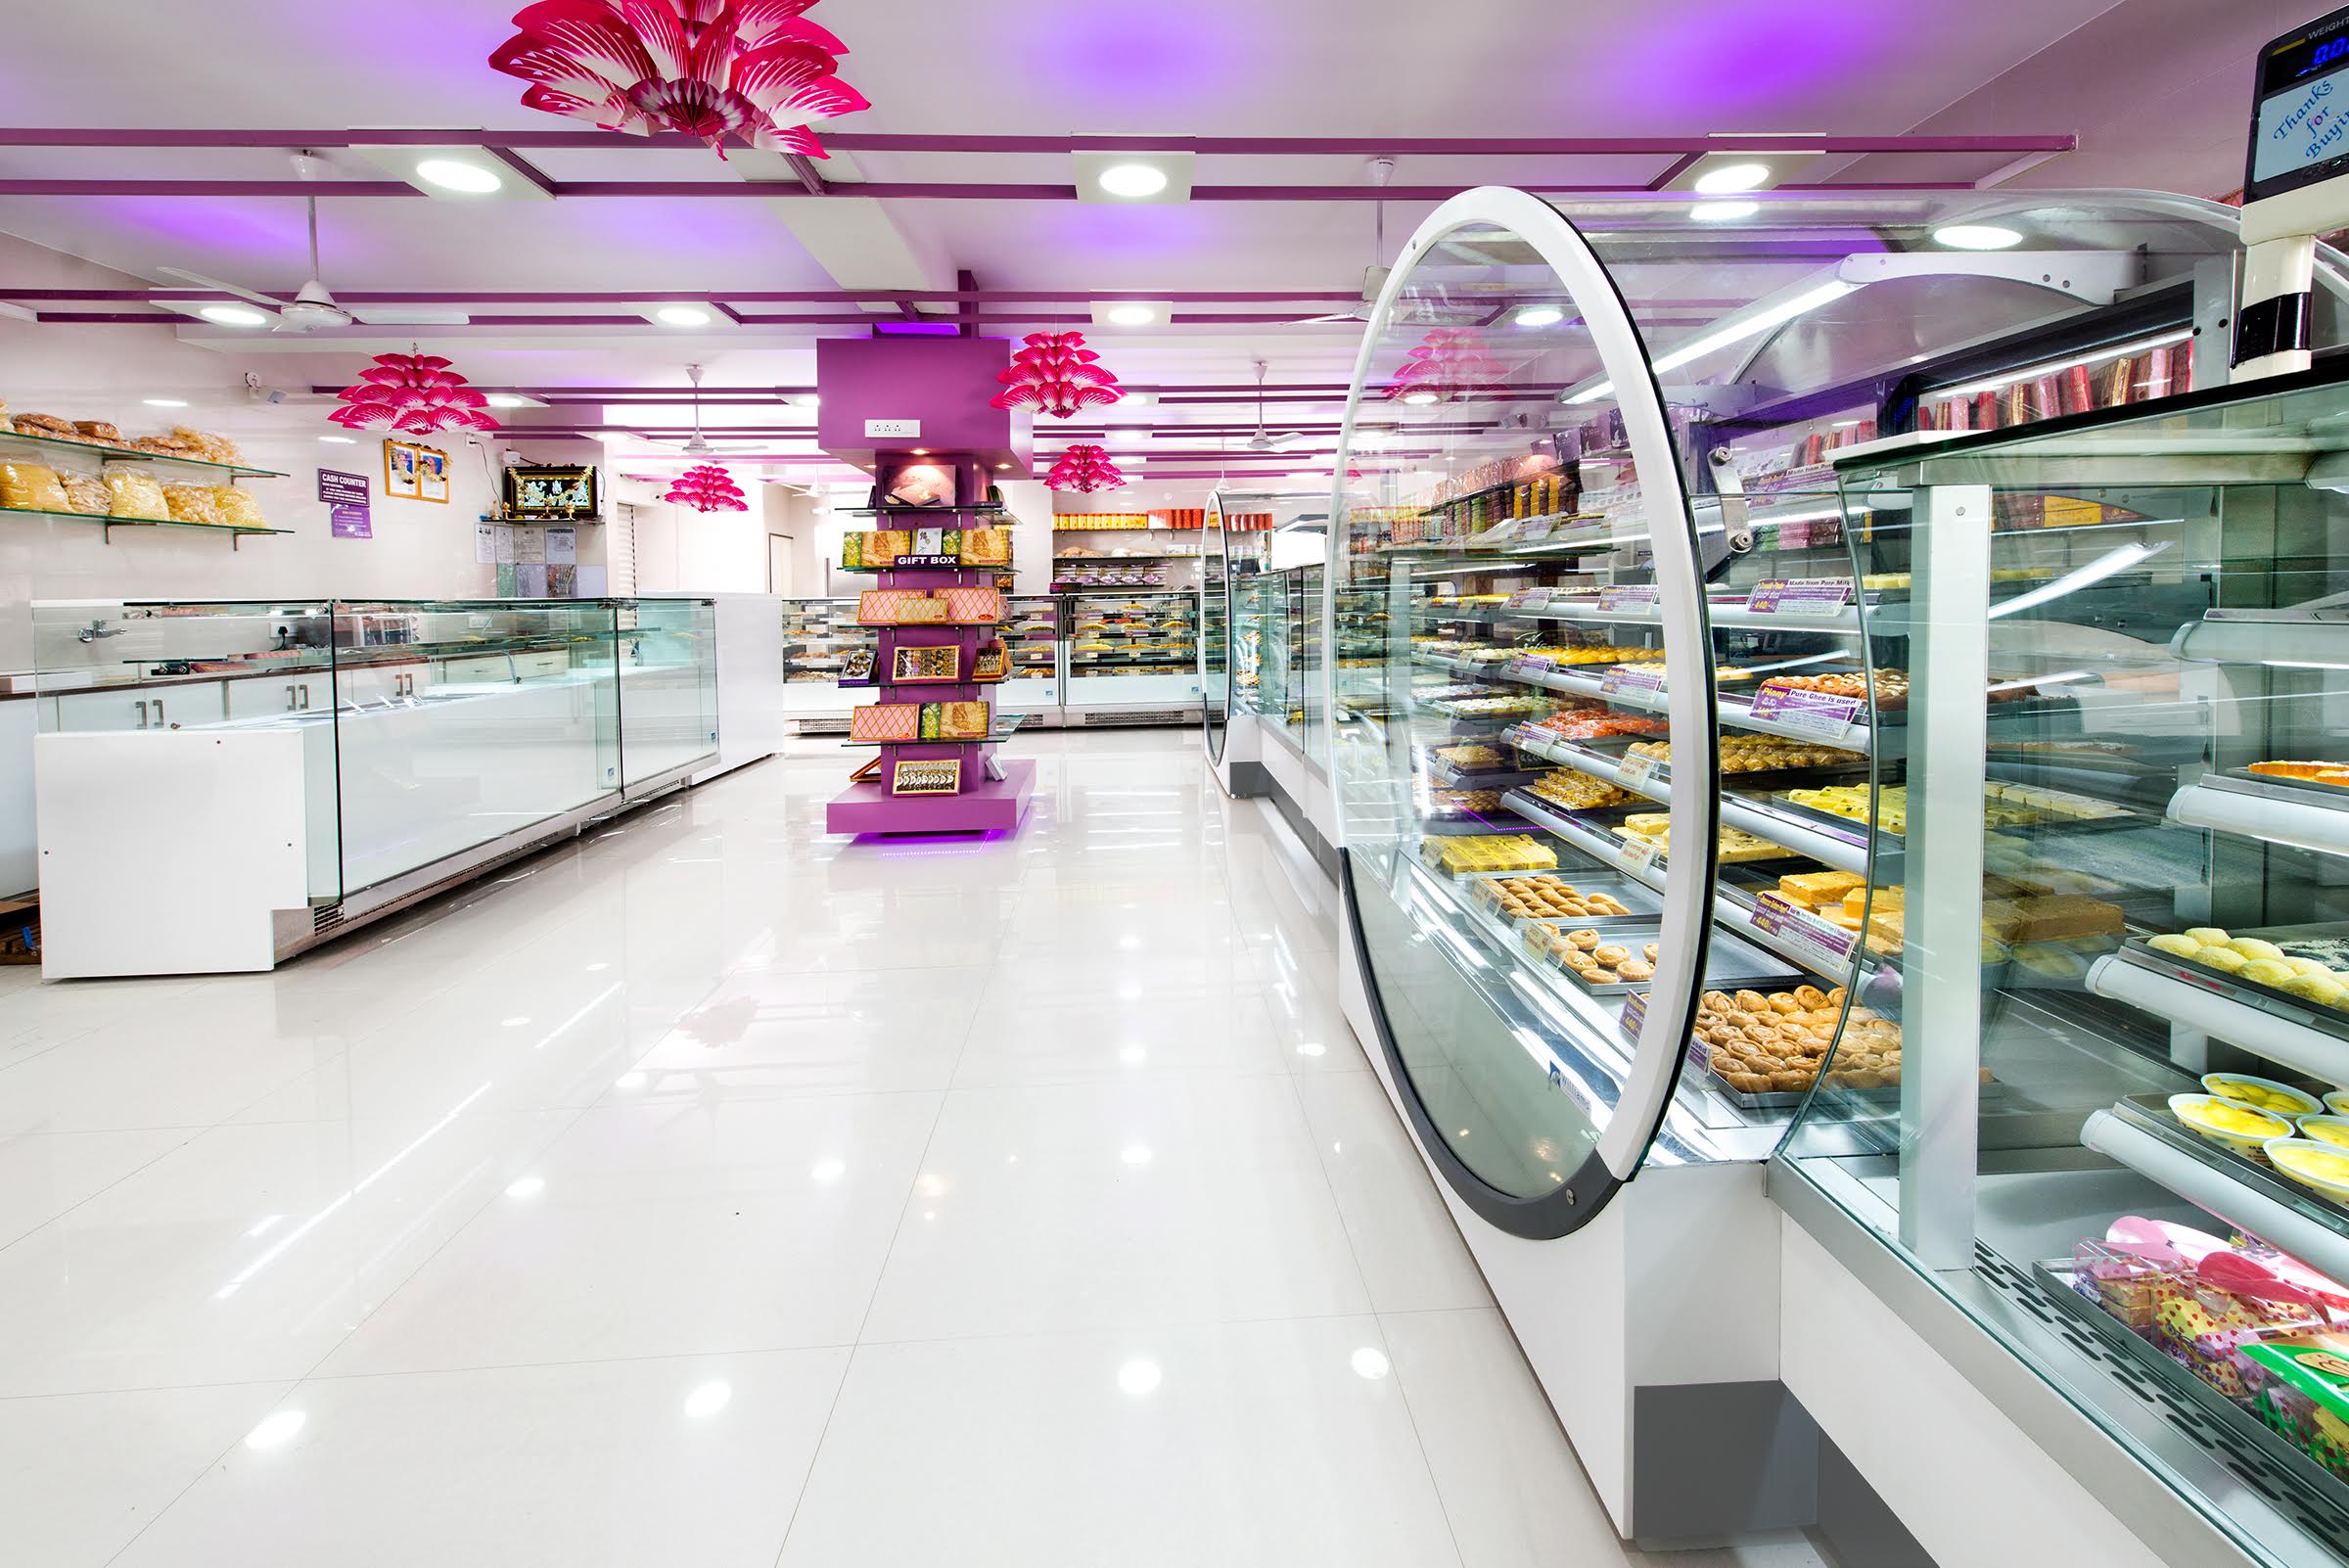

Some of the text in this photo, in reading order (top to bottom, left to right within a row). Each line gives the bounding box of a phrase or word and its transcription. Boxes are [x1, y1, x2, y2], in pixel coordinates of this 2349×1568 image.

[2273, 80, 2333, 139] Thanks
[2306, 106, 2330, 139] for
[322, 474, 367, 488] CASH COUNTER
[898, 556, 956, 565] GIFT BOX
[1761, 686, 1788, 699] Pinny
[1809, 693, 1827, 702] Ghee
